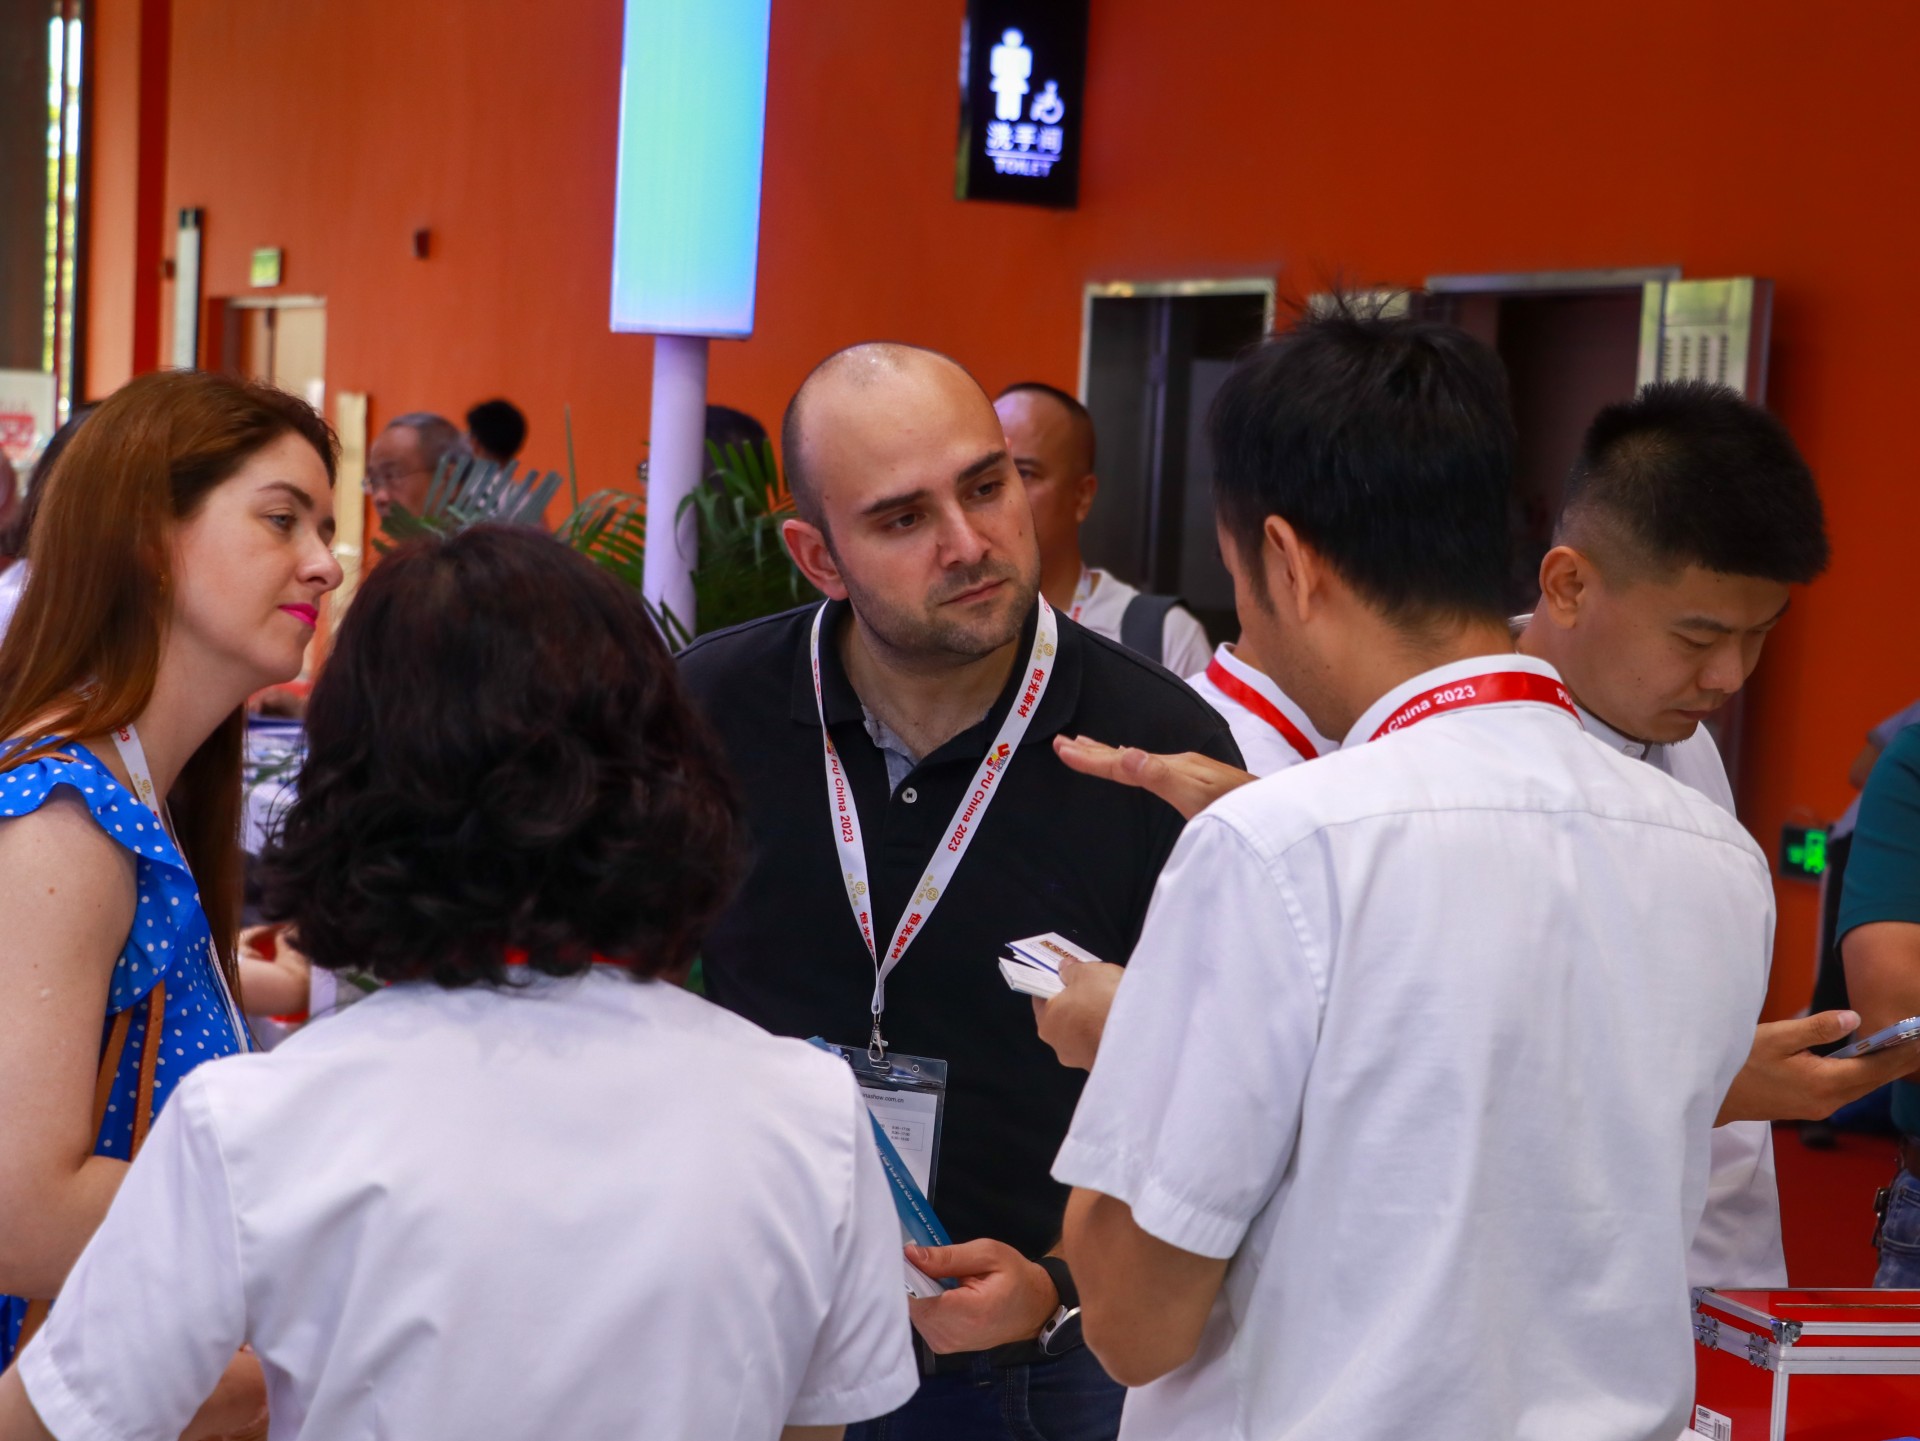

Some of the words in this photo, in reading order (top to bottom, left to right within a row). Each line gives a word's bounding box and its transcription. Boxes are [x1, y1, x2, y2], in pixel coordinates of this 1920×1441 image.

[986, 121, 1063, 154] 洗手间
[993, 157, 1052, 177] TOILET
[1017, 668, 1045, 718] 恒光新材
[1388, 699, 1431, 732] China
[1433, 685, 1476, 705] 2023
[831, 759, 841, 775] PU
[980, 770, 995, 790] PU
[834, 778, 847, 812] China
[962, 790, 985, 822] China
[840, 815, 854, 843] 2023
[947, 823, 968, 852] 2023
[891, 912, 922, 959] 恒光新材
